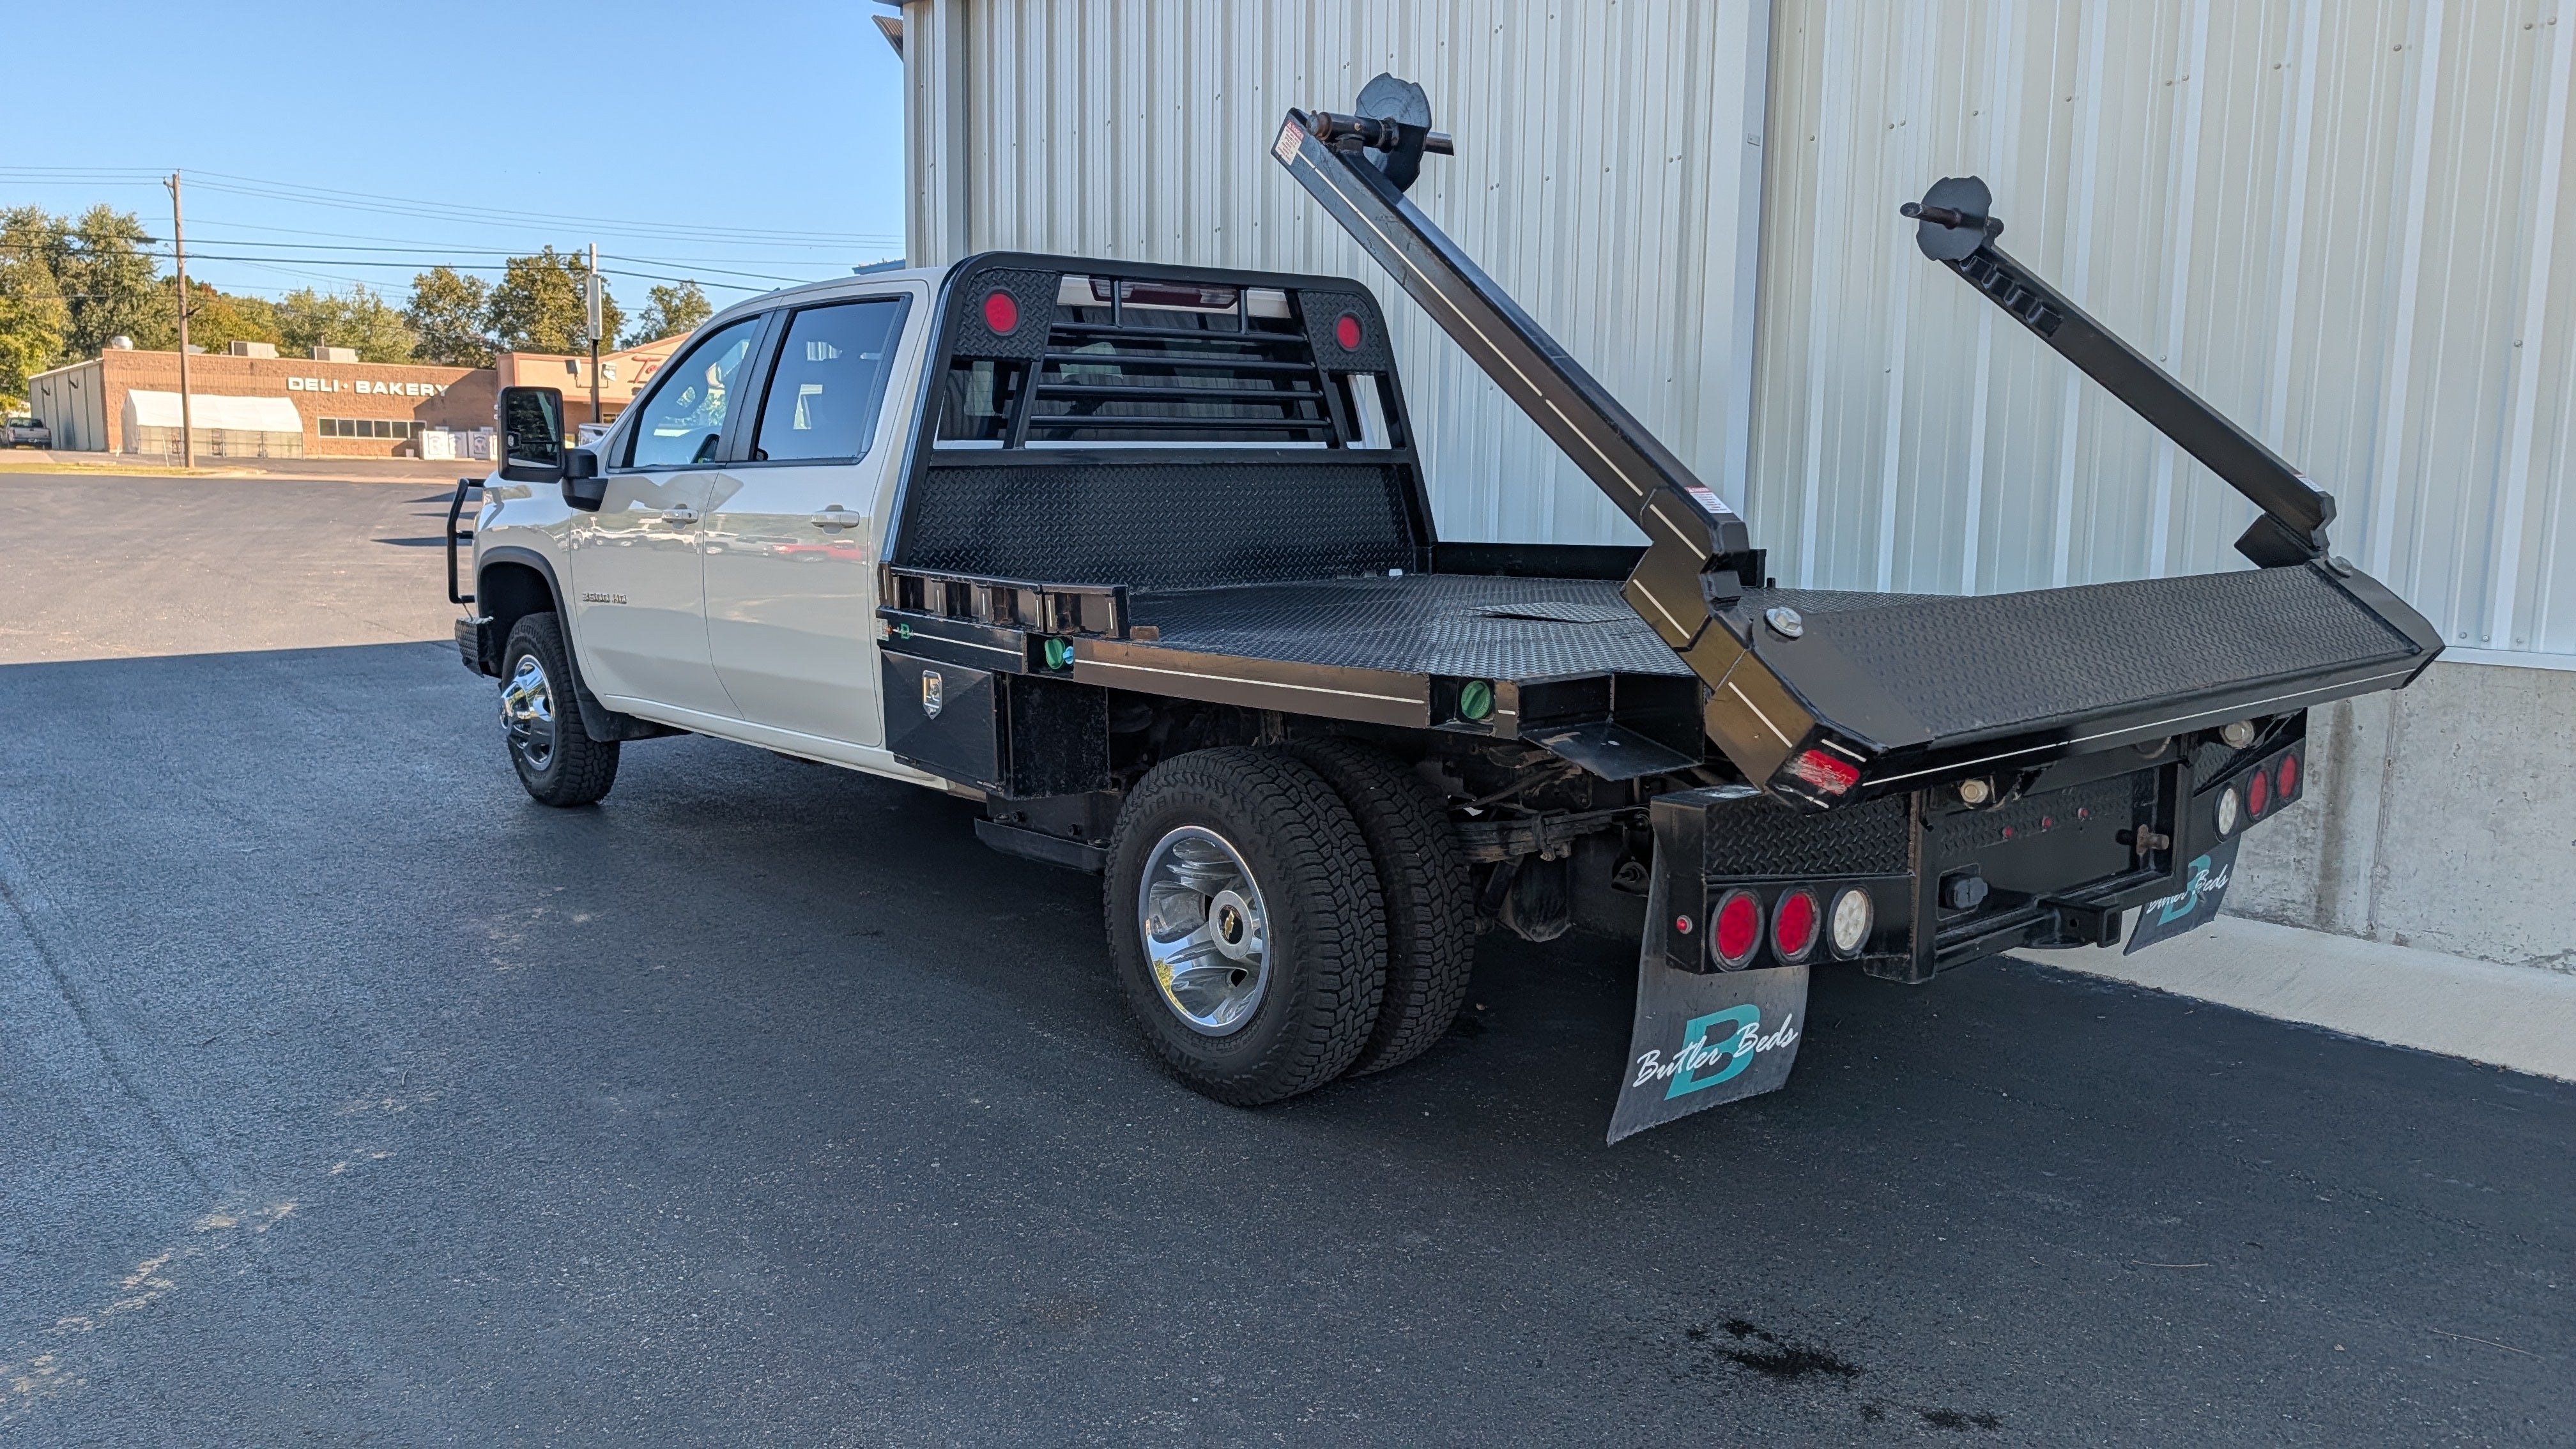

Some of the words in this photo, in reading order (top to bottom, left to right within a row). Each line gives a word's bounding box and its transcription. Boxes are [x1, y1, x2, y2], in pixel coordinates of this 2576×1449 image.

[288, 376, 339, 393] DELI
[355, 380, 450, 397] BAKERY
[582, 592, 610, 603] 3500
[612, 594, 627, 604] HD
[2192, 863, 2229, 895] Beds
[1632, 1035, 1722, 1087] Butler
[1732, 1013, 1799, 1058] Beds
